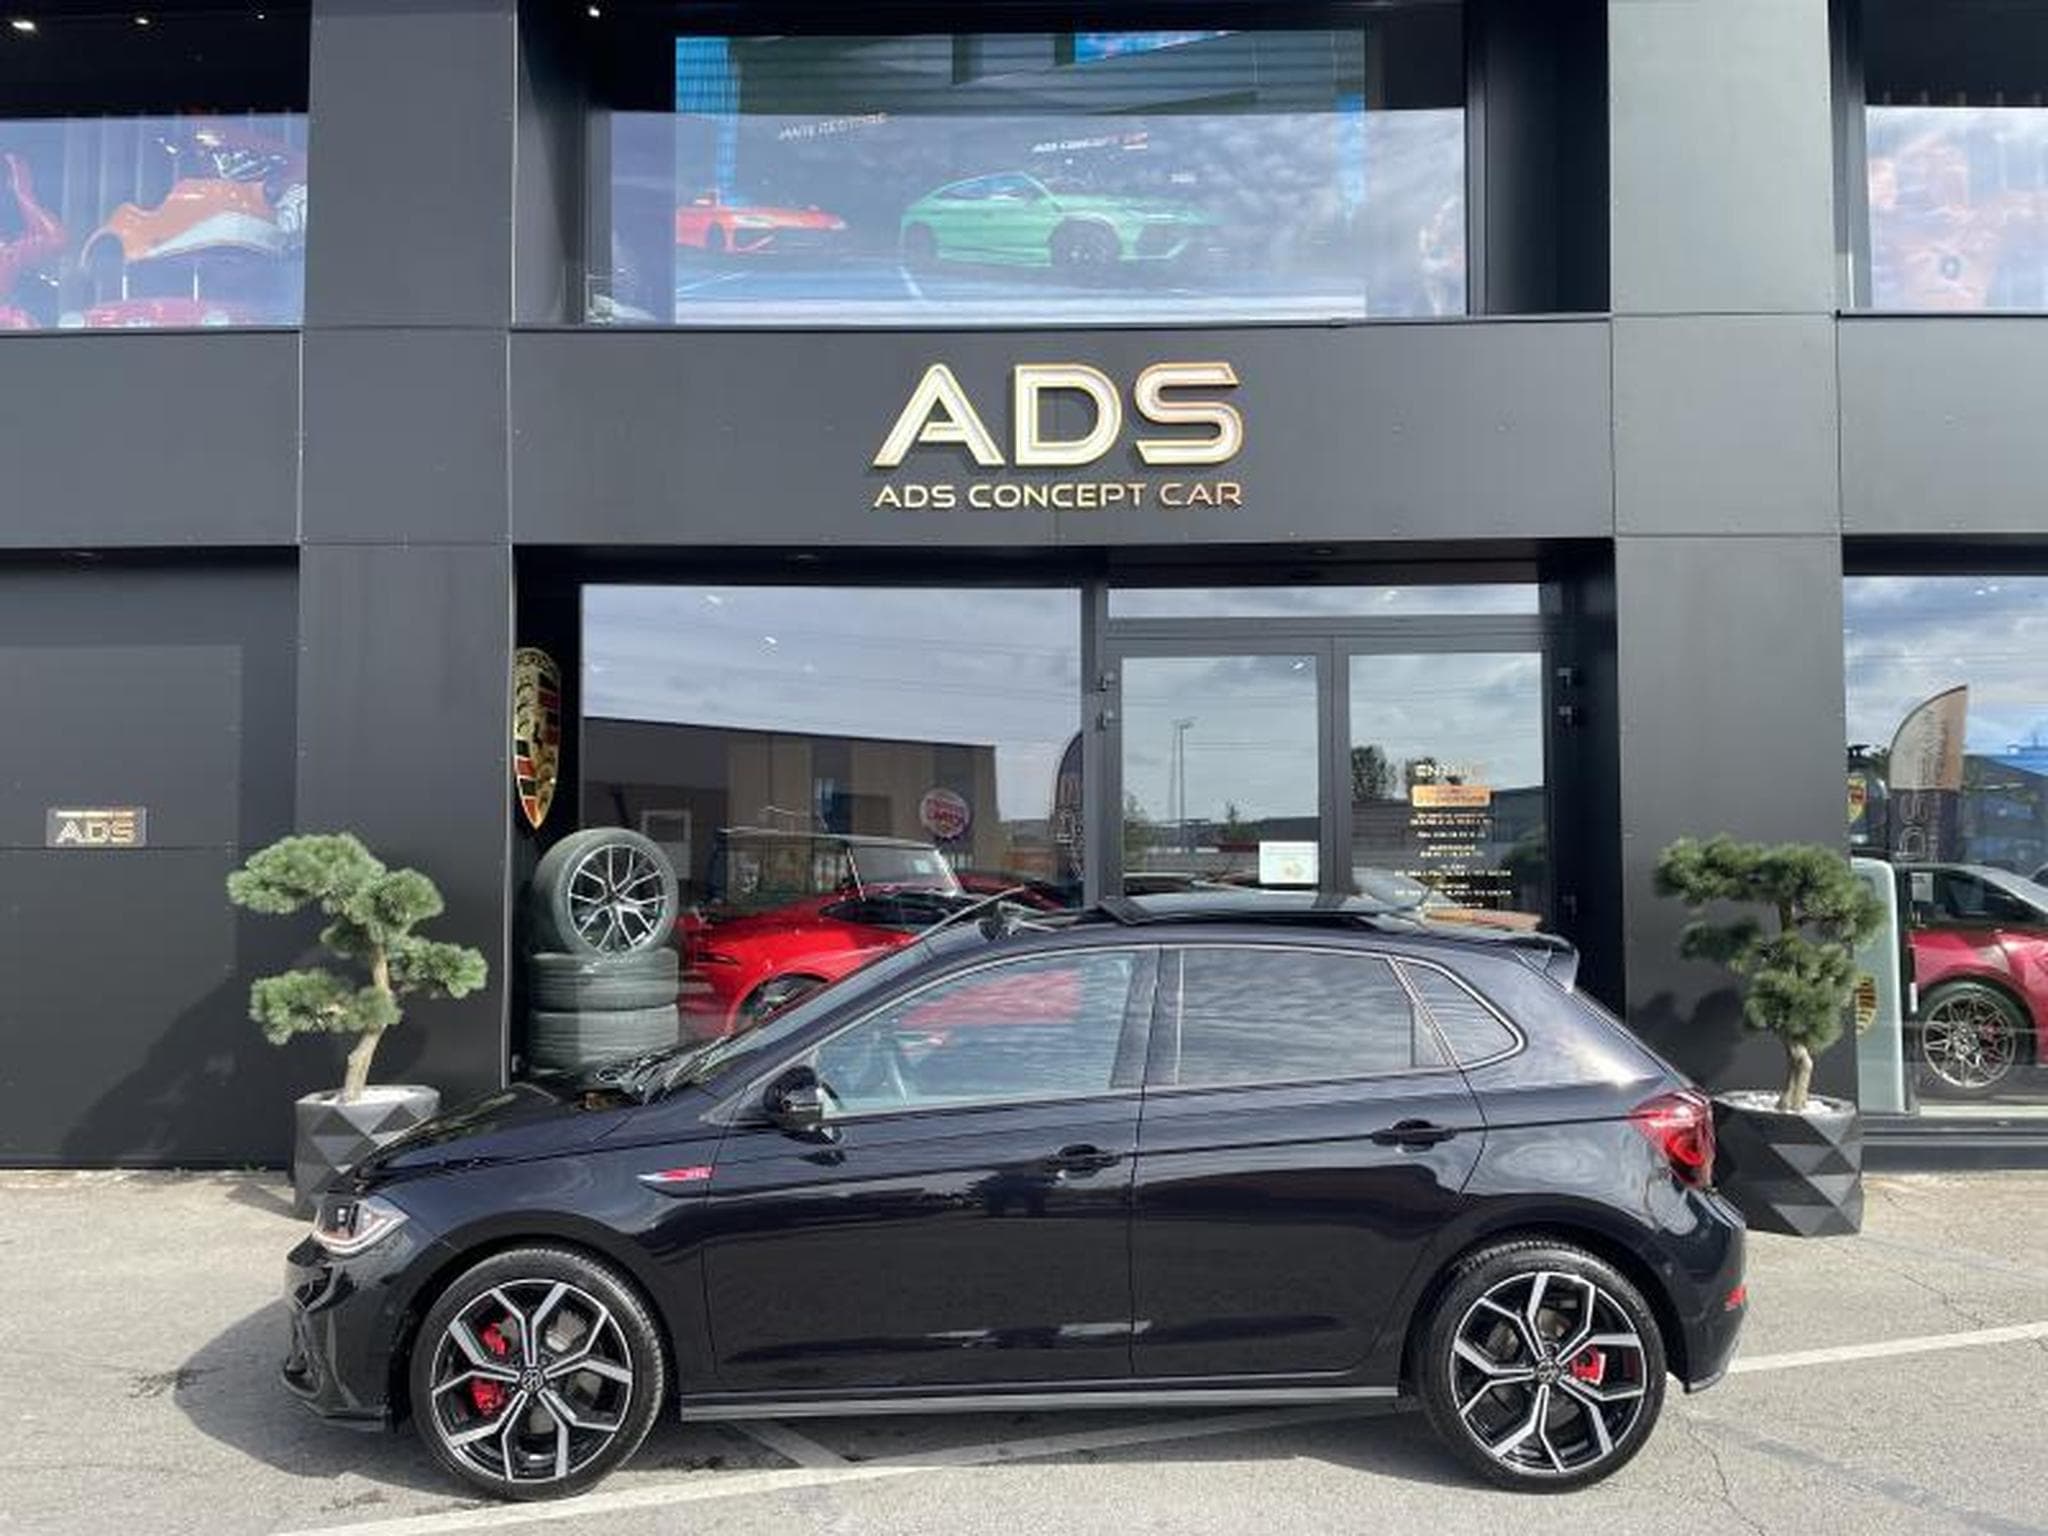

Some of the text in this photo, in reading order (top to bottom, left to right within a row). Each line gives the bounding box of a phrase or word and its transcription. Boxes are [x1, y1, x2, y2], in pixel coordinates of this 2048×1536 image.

[872, 362, 1244, 466] ADS
[873, 482, 1243, 508] ADS CONCEPT CAR
[56, 818, 135, 844] ADS
